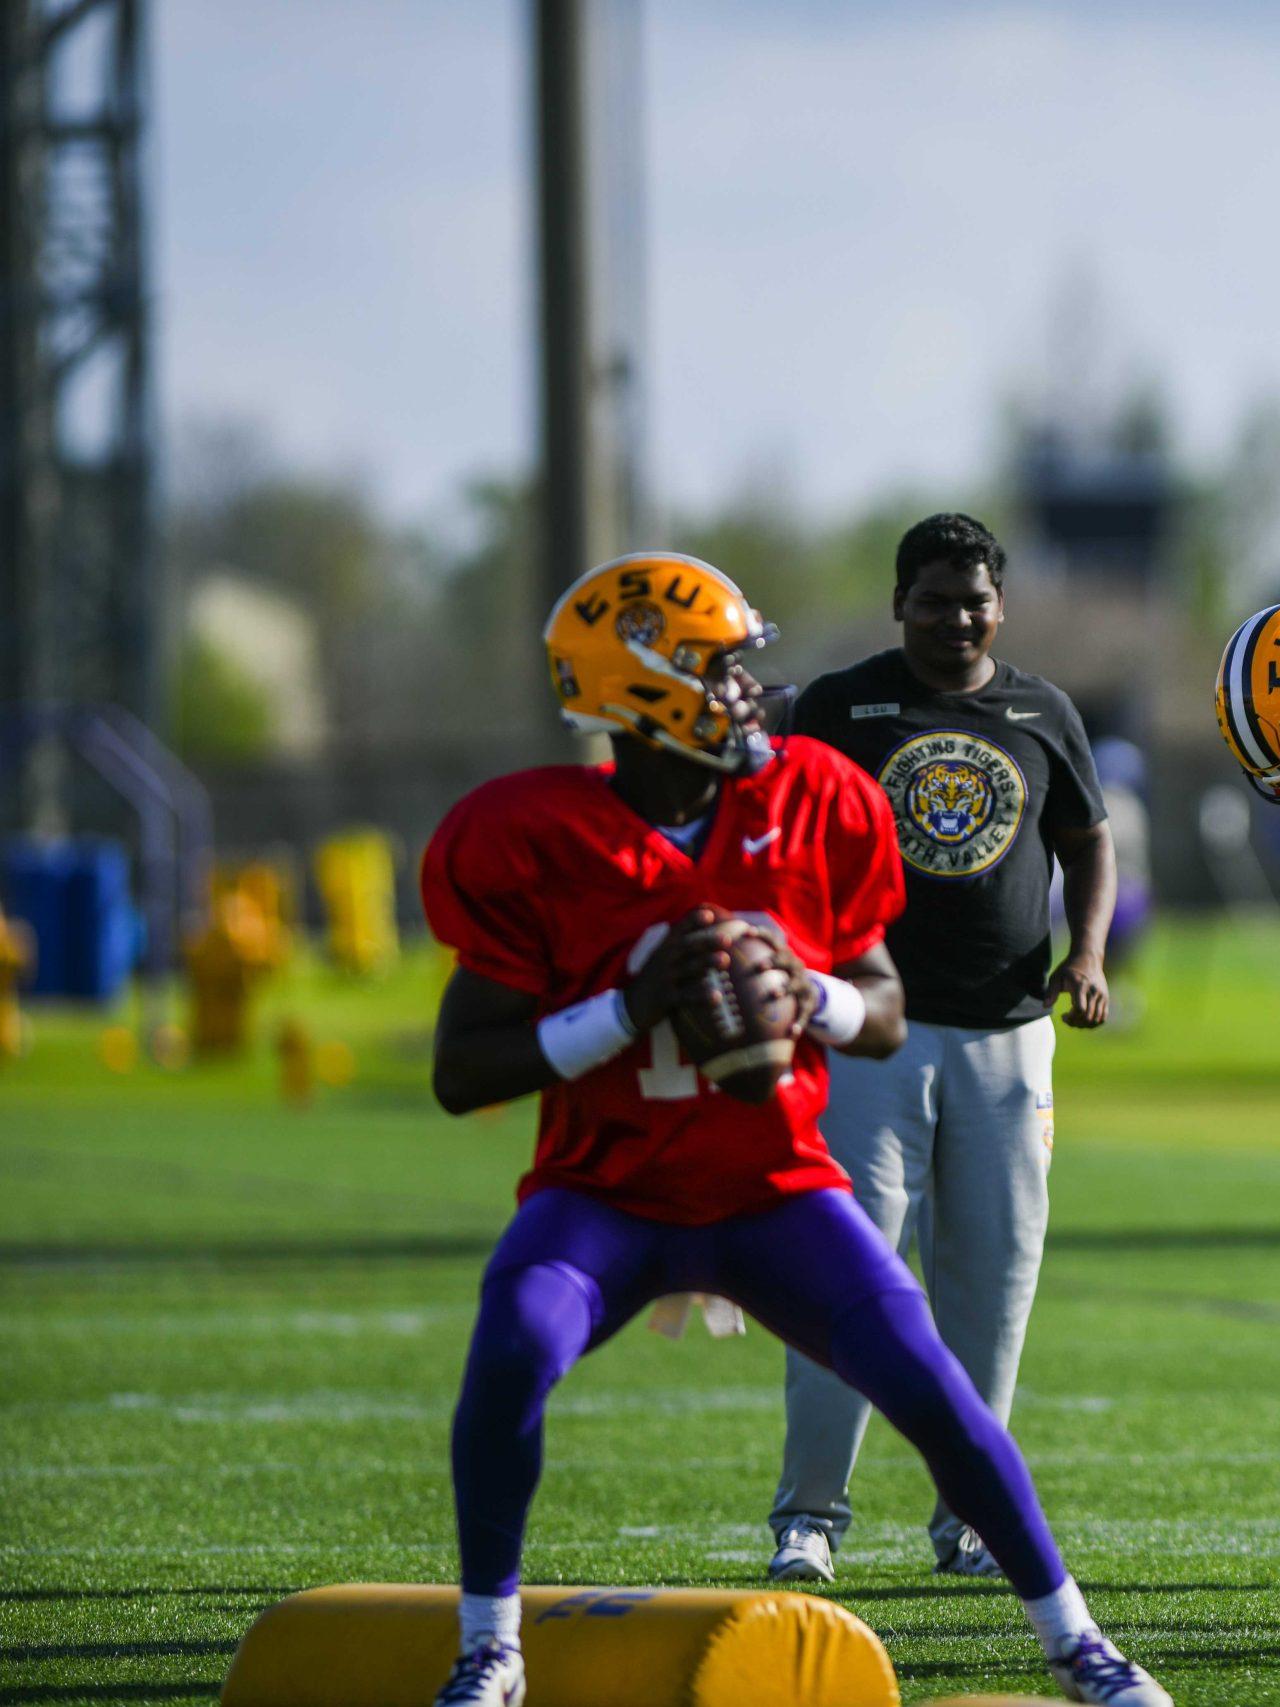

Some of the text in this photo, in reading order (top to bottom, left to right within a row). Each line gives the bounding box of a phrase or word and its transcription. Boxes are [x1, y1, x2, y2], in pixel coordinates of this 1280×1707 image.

[574, 568, 701, 626] LSU
[886, 740, 1016, 793] FIGHTING TIGERS
[949, 816, 1012, 867] VALLEY
